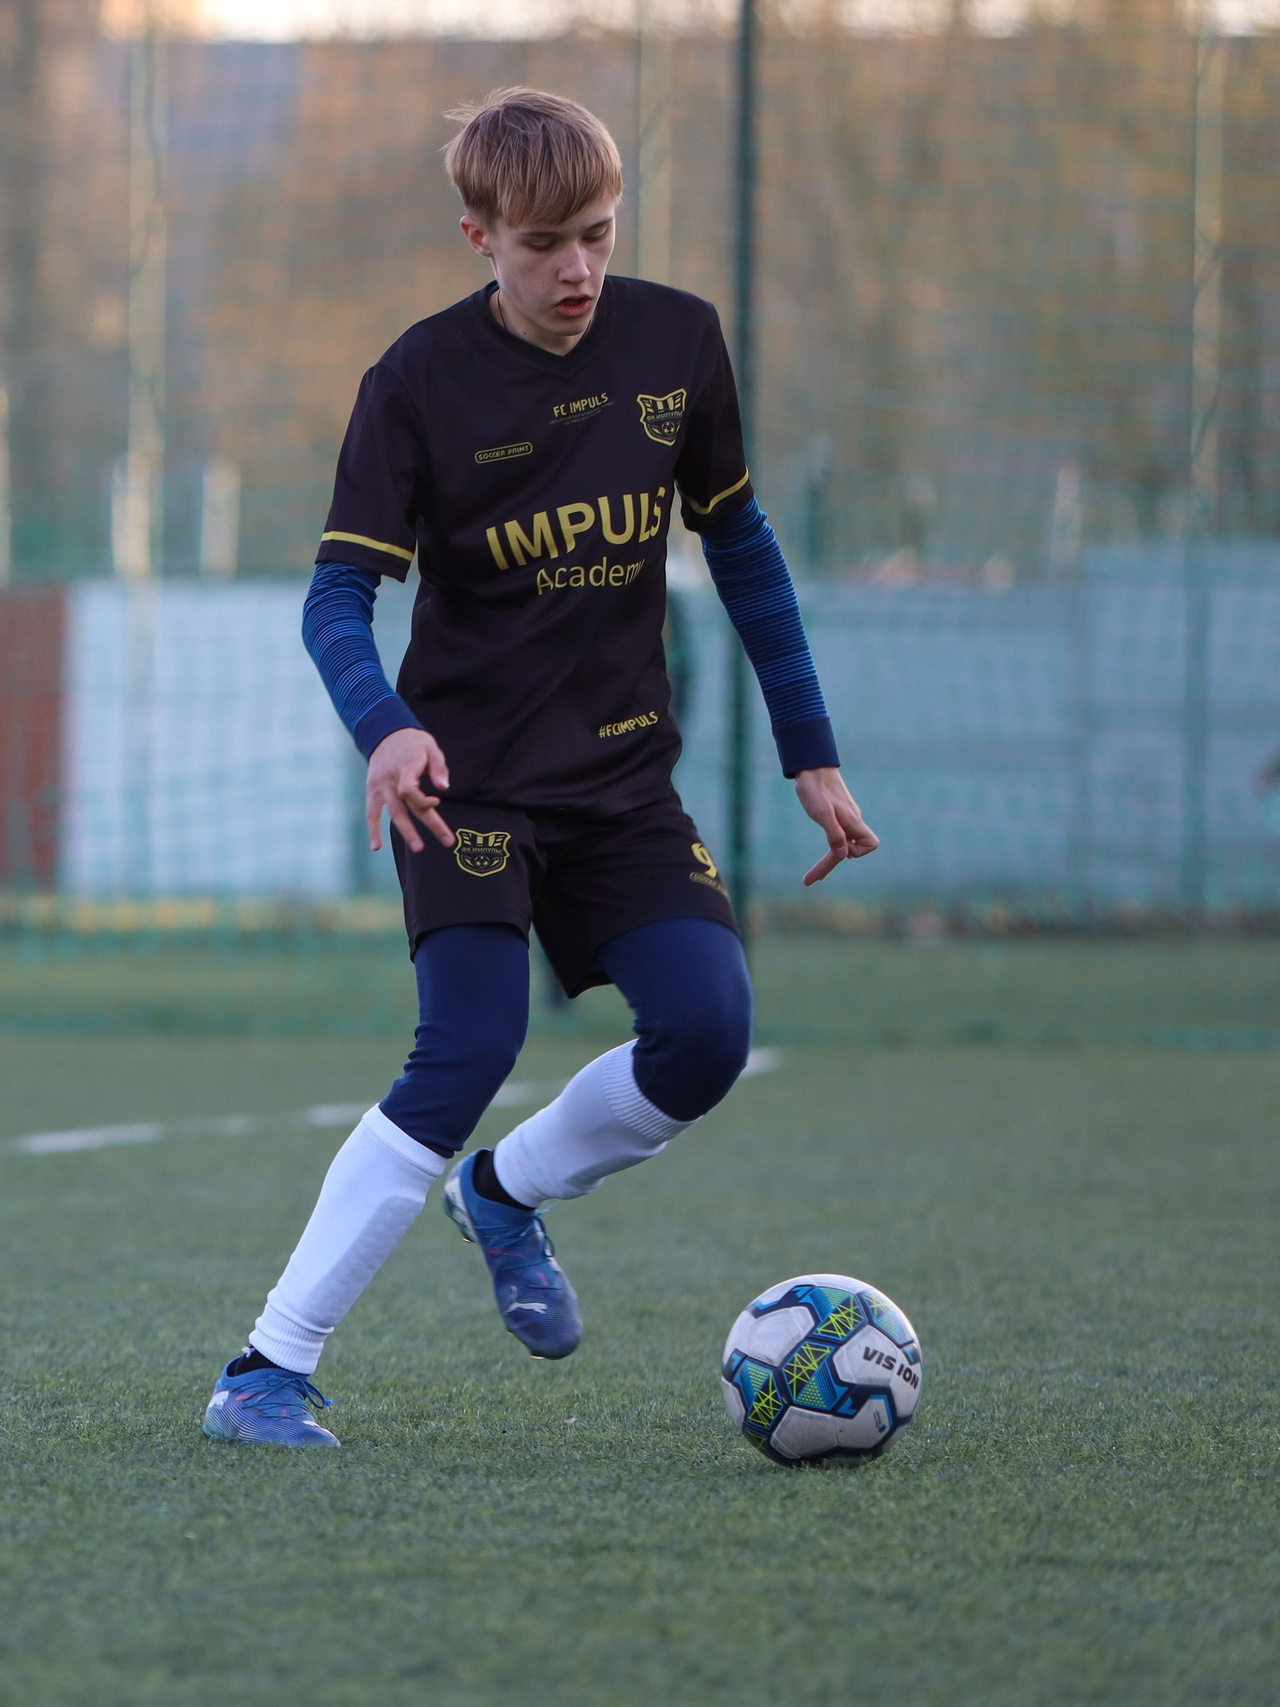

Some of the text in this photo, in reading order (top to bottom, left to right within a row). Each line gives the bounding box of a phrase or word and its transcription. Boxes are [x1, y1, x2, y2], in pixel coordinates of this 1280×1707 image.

[553, 403, 567, 418] FC
[569, 392, 609, 414] IMPULS
[598, 711, 658, 739] #FCIMPULS
[691, 842, 718, 880] 9
[863, 1346, 919, 1390] VISION
